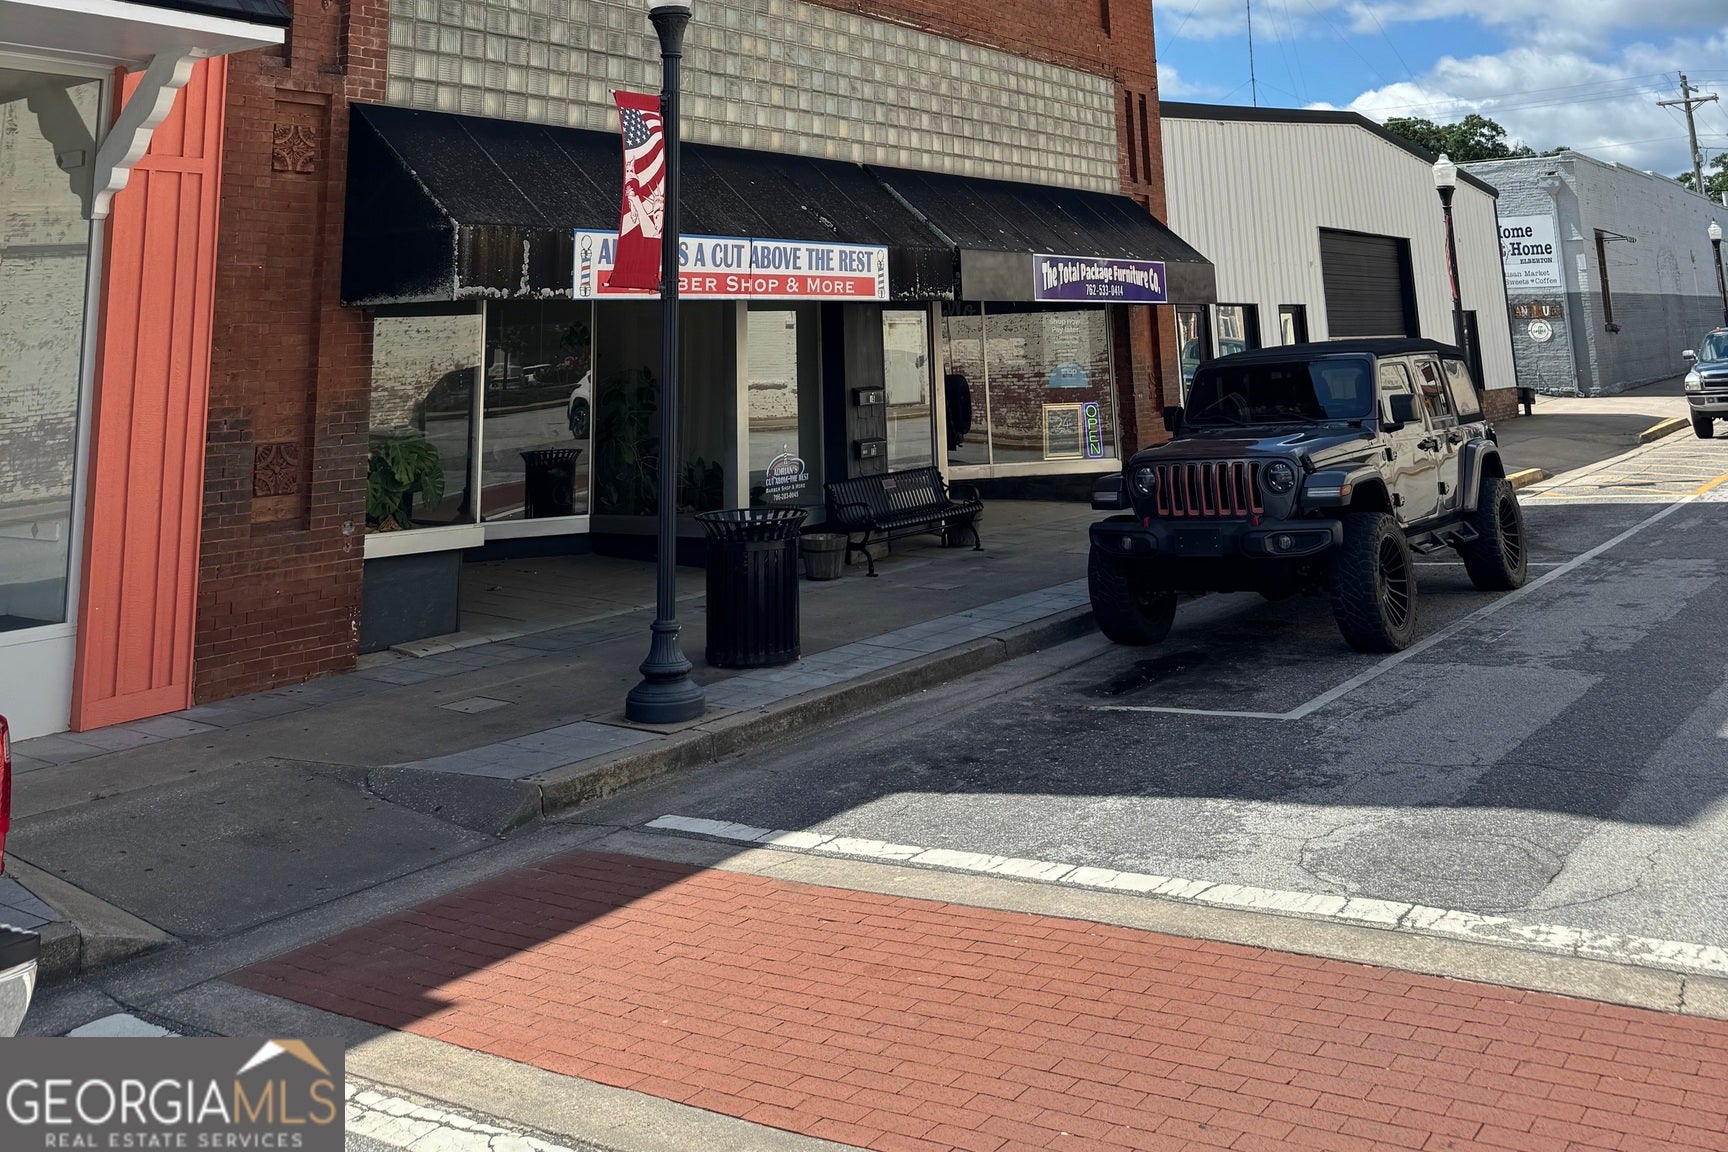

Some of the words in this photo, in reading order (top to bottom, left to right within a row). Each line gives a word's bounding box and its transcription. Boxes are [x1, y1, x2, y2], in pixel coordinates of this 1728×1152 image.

[1500, 226, 1533, 239] ome
[694, 242, 706, 267] A
[711, 244, 745, 268] CUT
[749, 245, 801, 270] ABOVE
[806, 248, 835, 272] THE
[839, 250, 873, 273] REST
[1509, 242, 1552, 256] Home
[679, 277, 717, 291] BER
[726, 276, 778, 292] SHOP
[786, 277, 799, 292] &
[807, 278, 855, 294] MORE
[1042, 260, 1058, 290] The
[1058, 262, 1080, 285] Total
[1080, 262, 1113, 283] Package
[1113, 265, 1148, 288] Furniture
[1085, 405, 1101, 455] OPEN
